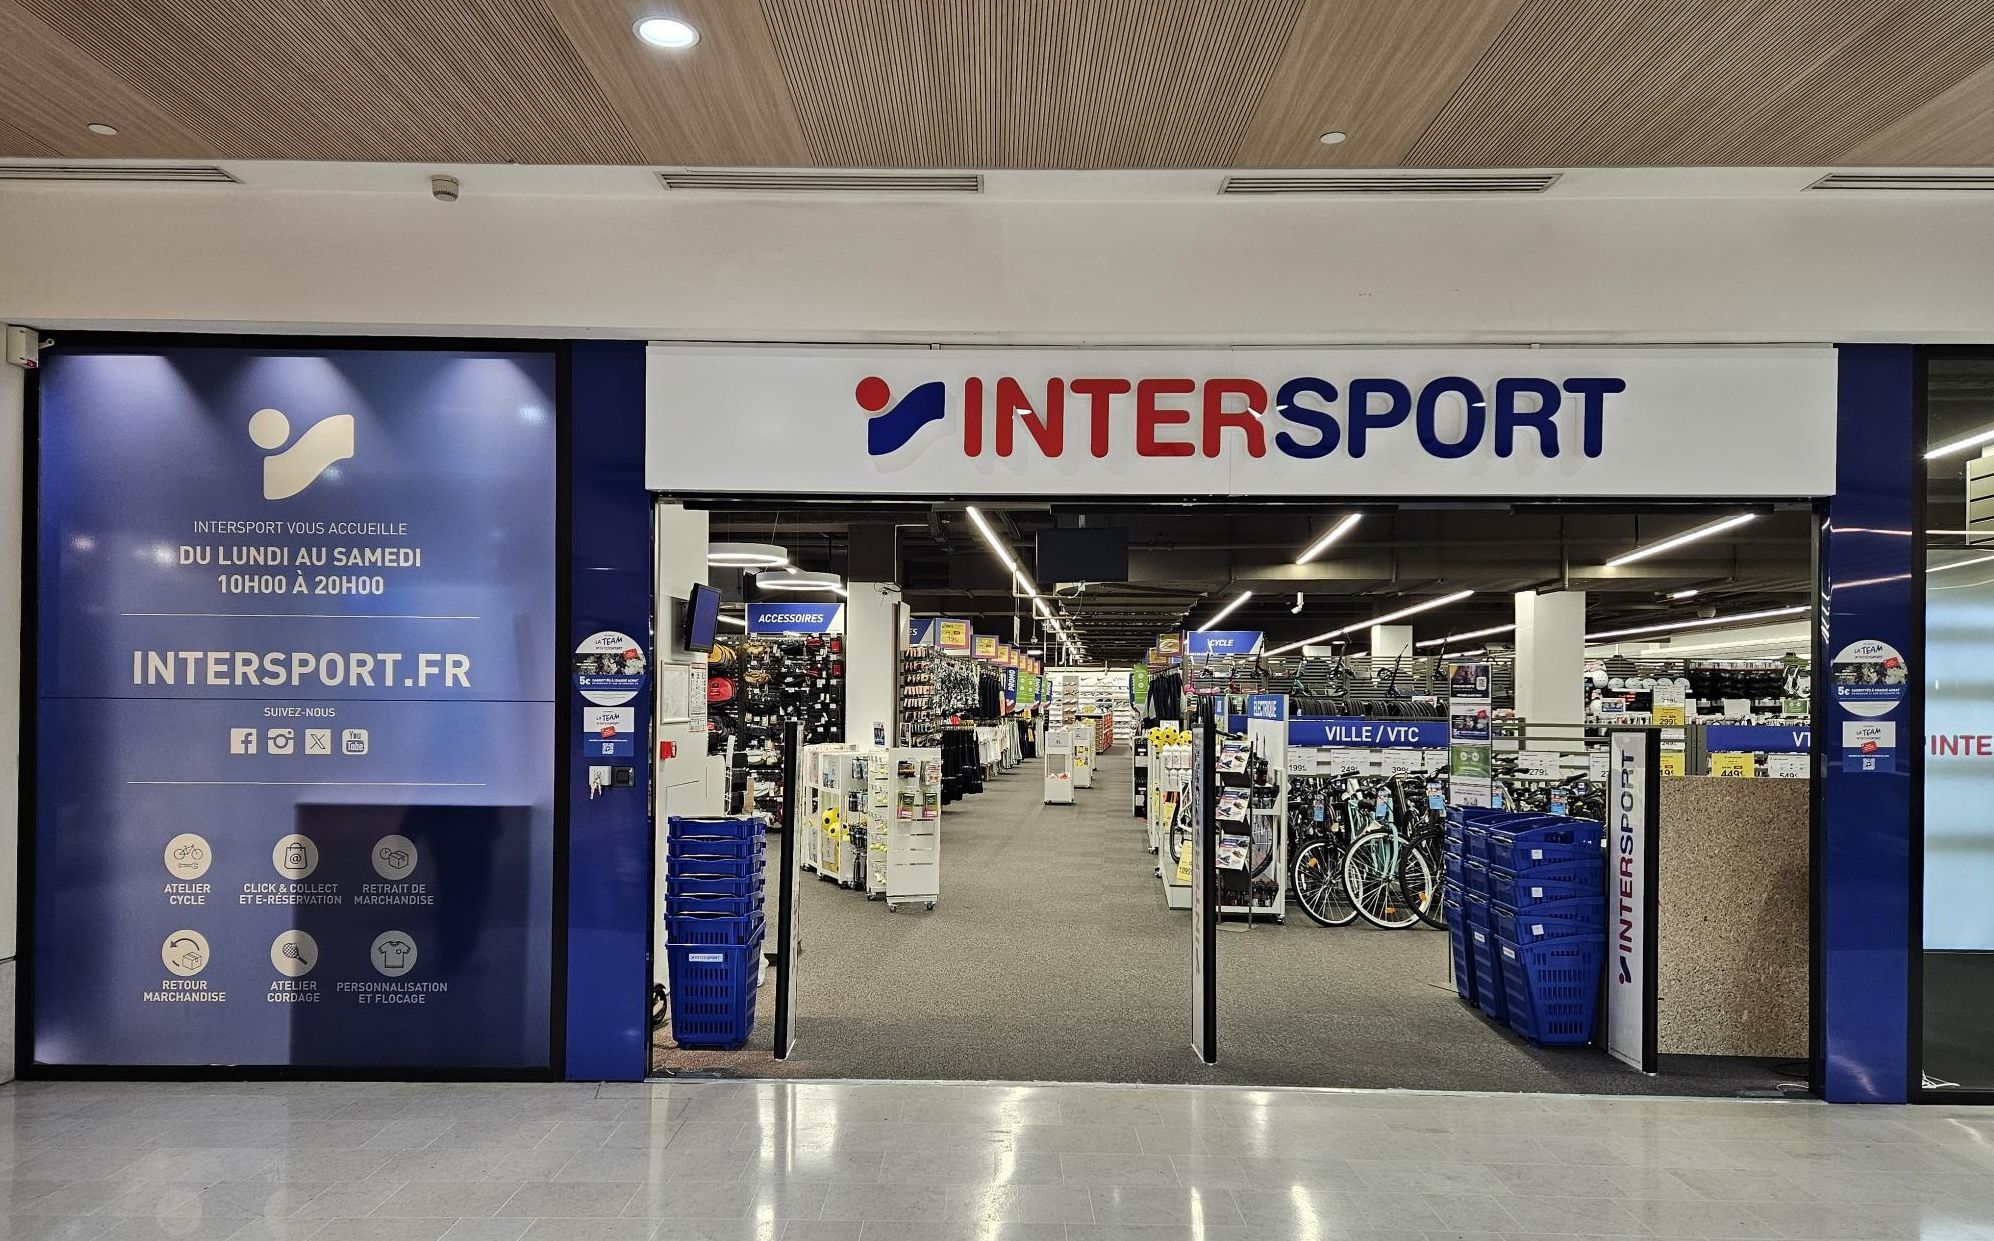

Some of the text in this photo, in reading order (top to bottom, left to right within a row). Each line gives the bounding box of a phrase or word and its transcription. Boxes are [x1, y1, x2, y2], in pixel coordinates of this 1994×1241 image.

[963, 376, 1627, 459] INTERSPORT
[194, 521, 408, 536] INTERSPORT VOUS ACCUEILLE
[179, 545, 421, 567] DU LUNDI AU SAMEDI
[217, 570, 385, 595] 10H00 À 20H00
[758, 613, 824, 623] ACCESSOIRES
[602, 636, 623, 646] TEAM
[1210, 639, 1235, 647] CYCLE
[1861, 645, 1883, 655] TEAM
[133, 651, 471, 687] INTERSPORT.FR
[264, 707, 336, 718] SUIVEZ-NOUS
[1325, 725, 1419, 743] VILLE / VTC
[1619, 749, 1636, 954] INTERSPORT
[164, 883, 211, 894] ATELIER
[243, 883, 338, 894] CLICK & COLLECT
[362, 883, 426, 894] RETRAIT DE
[169, 895, 206, 905] CYCLE
[239, 892, 342, 905] ET E-RÉSERVATION
[353, 895, 435, 905] MARCHANDISE
[162, 980, 208, 991] RETOUR
[270, 980, 317, 991] ATELIER
[336, 982, 448, 993] PERSONNALISATION
[143, 991, 226, 1003] MARCHANDISE
[267, 991, 321, 1003] CORDAGE
[358, 993, 426, 1004] ET FLOCAGE
